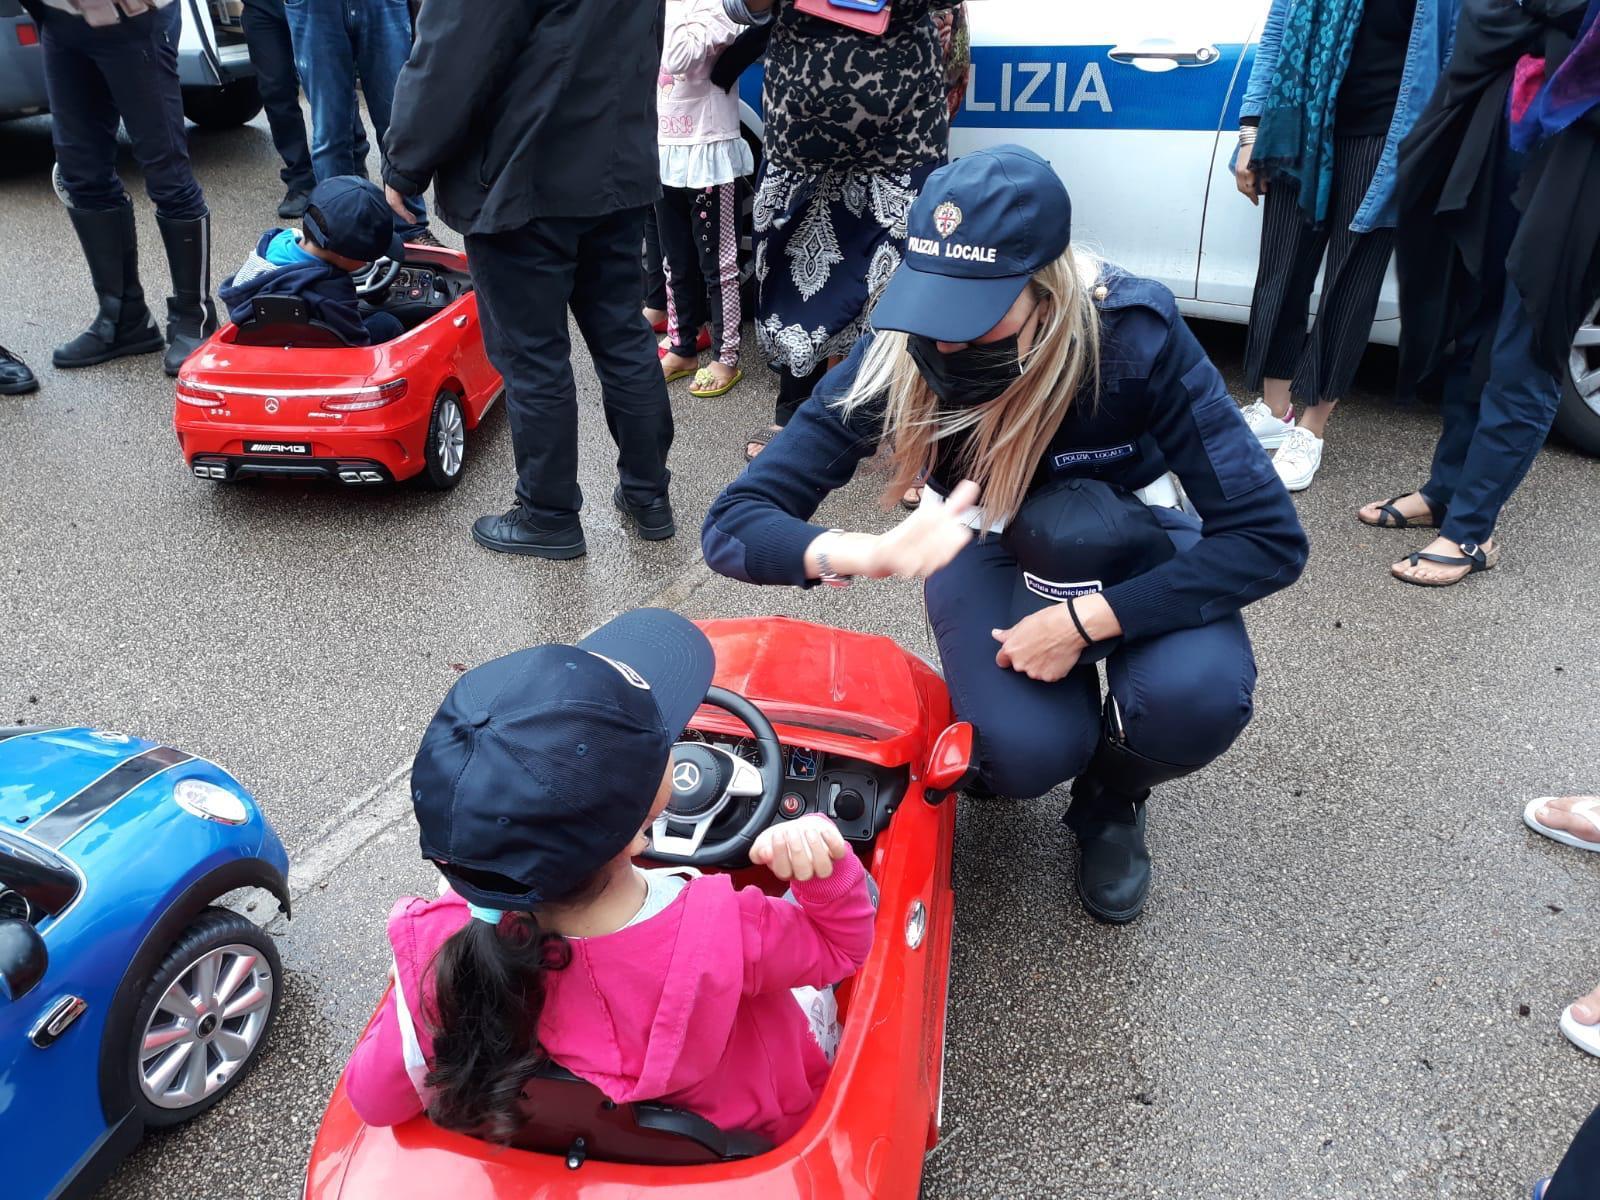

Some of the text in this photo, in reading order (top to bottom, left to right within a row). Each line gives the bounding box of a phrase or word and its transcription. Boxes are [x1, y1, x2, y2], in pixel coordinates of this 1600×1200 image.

[945, 243, 997, 263] LOCALE
[1062, 448, 1124, 463] POLIZIA LOCALE
[1050, 587, 1097, 597] Municipale
